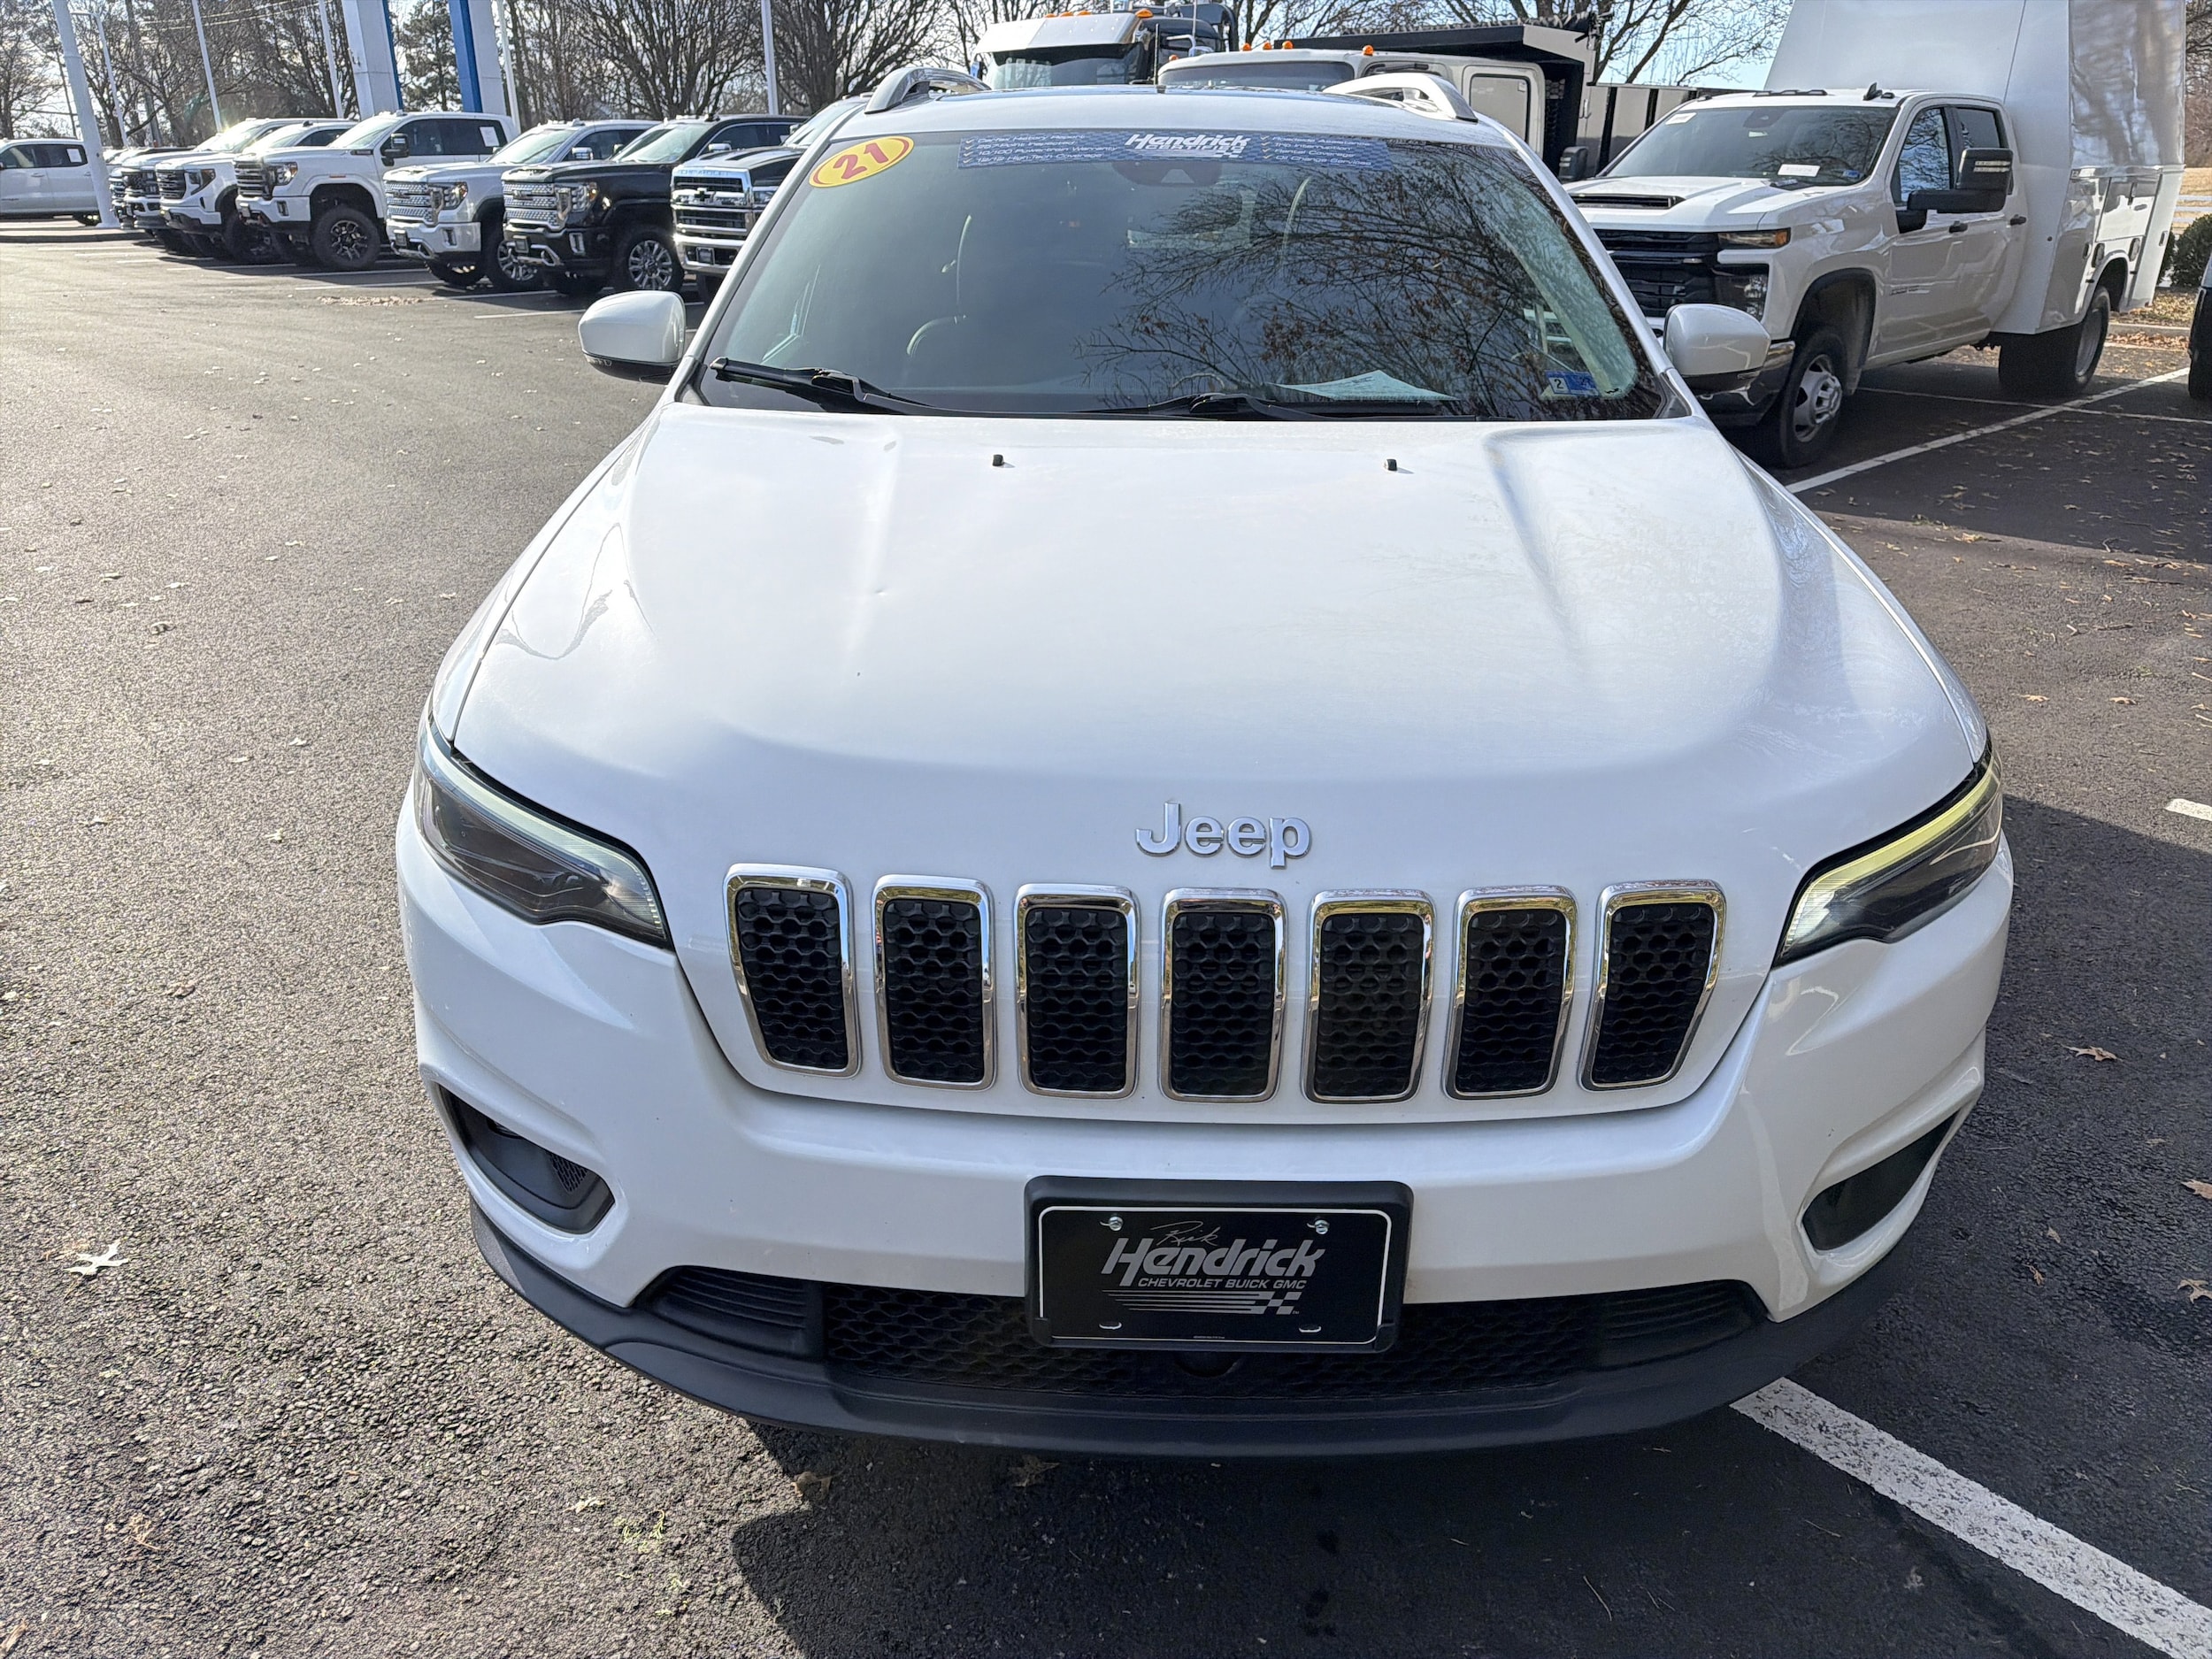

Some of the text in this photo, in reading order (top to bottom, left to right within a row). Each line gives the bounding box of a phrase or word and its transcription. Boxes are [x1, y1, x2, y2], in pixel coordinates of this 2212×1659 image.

[1124, 134, 1252, 150] Hendrick
[833, 142, 889, 180] 21
[1290, 155, 1329, 164] Change
[1309, 150, 1356, 158] Coverage
[1554, 379, 1564, 389] 2
[1135, 800, 1313, 871] Jeep
[1101, 1237, 1326, 1287] Hendrick
[1138, 1277, 1308, 1290] CHEVROLET BUICK GMC
